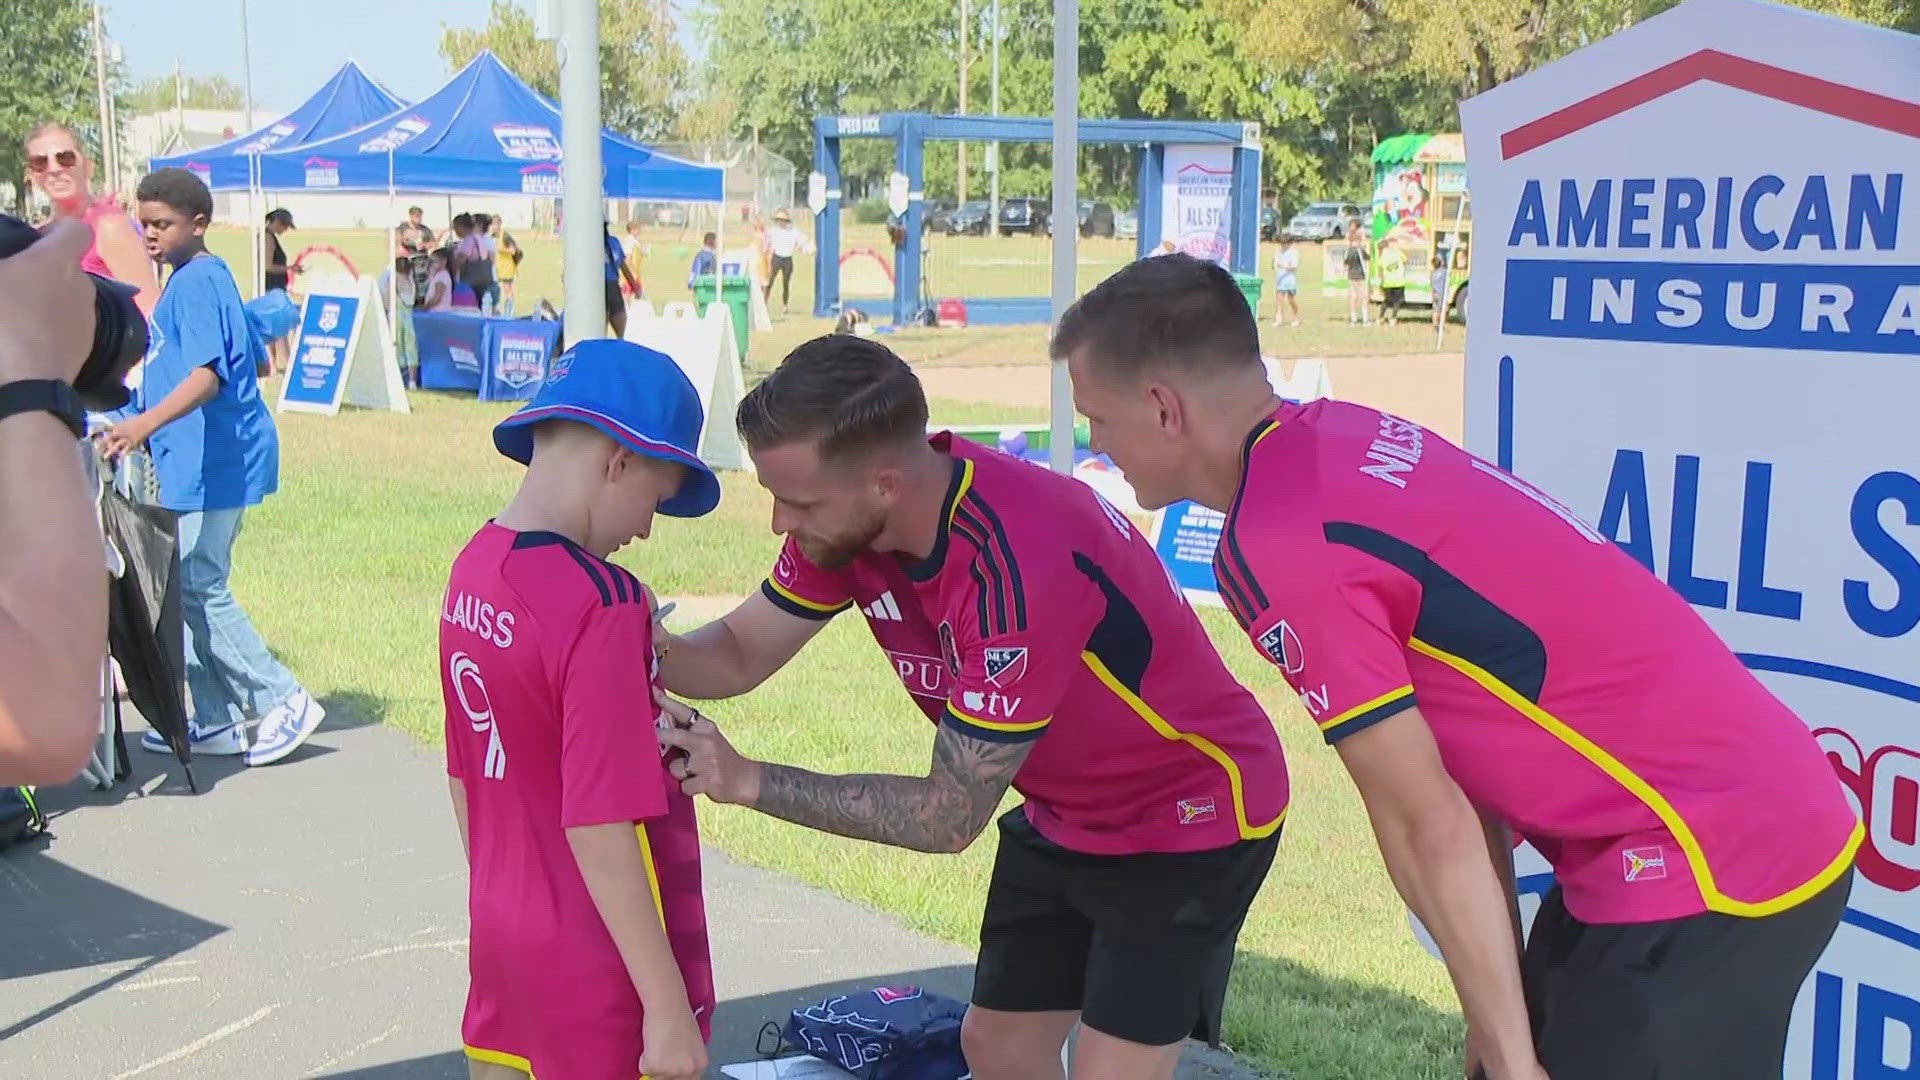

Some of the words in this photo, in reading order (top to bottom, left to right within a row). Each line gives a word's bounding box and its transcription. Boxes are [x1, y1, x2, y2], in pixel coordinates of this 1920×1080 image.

[1186, 207, 1203, 226] ALL
[1206, 208, 1224, 227] STL
[1507, 173, 1904, 252] AMERICAN
[1549, 276, 1920, 336] INSURA
[1597, 449, 1802, 621] ALL
[897, 659, 943, 690] PU
[988, 651, 1011, 661] MLS
[450, 651, 507, 780] 9
[988, 691, 1022, 718] tv
